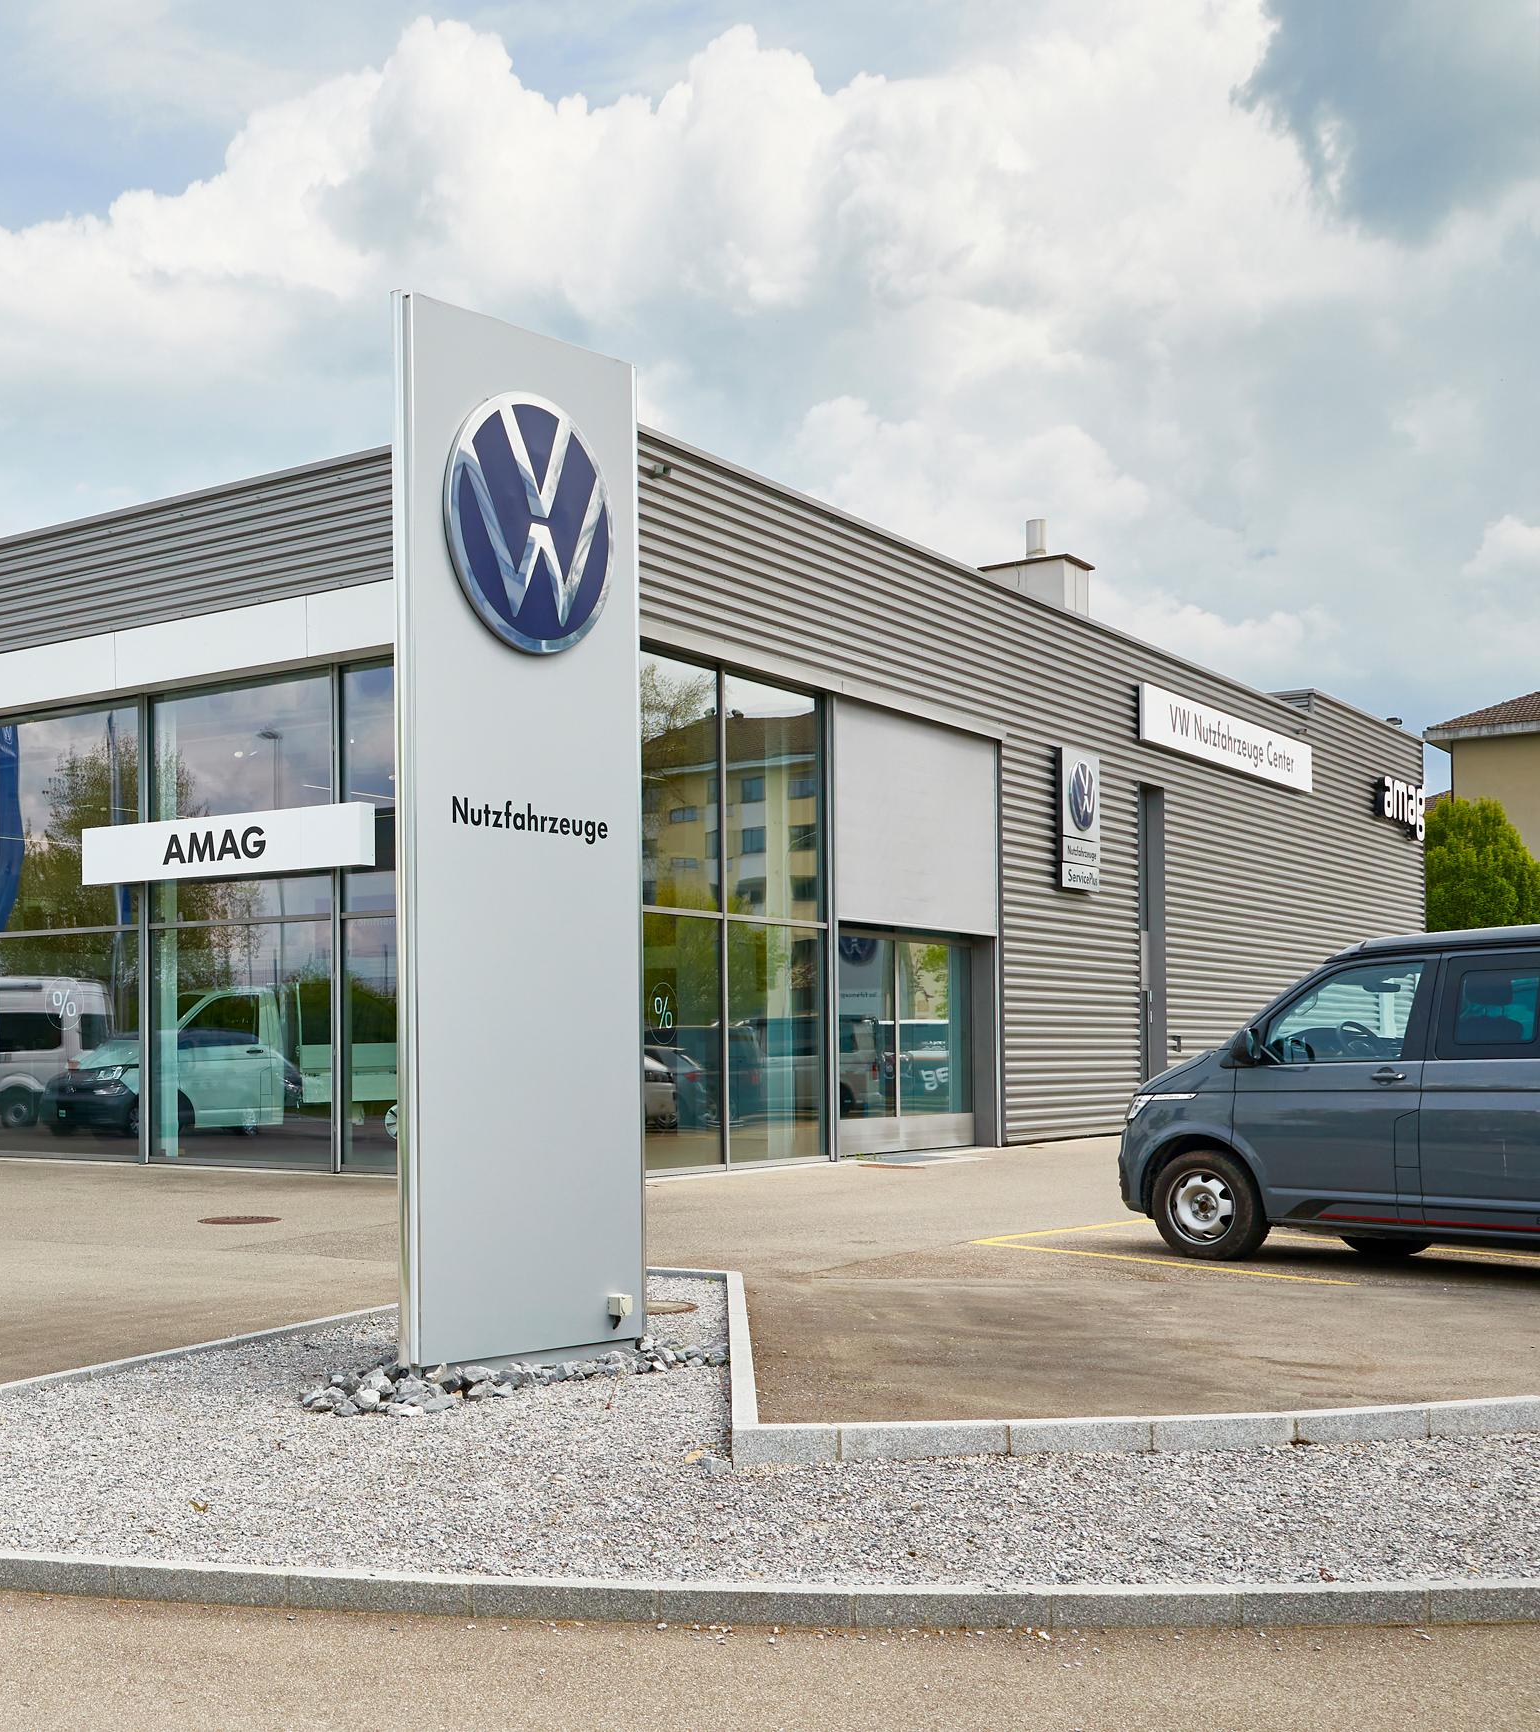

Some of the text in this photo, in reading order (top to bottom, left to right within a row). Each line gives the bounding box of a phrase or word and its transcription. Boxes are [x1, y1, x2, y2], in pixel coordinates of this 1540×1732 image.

[1169, 703, 1295, 774] VW Nutzfahrzeuge Center
[449, 796, 610, 845] Nutzfahrzeuge
[1383, 775, 1426, 842] amag
[162, 825, 267, 866] AMAG
[1066, 844, 1098, 861] Nutzfahrzeuge
[1067, 868, 1099, 887] ServicePlus
